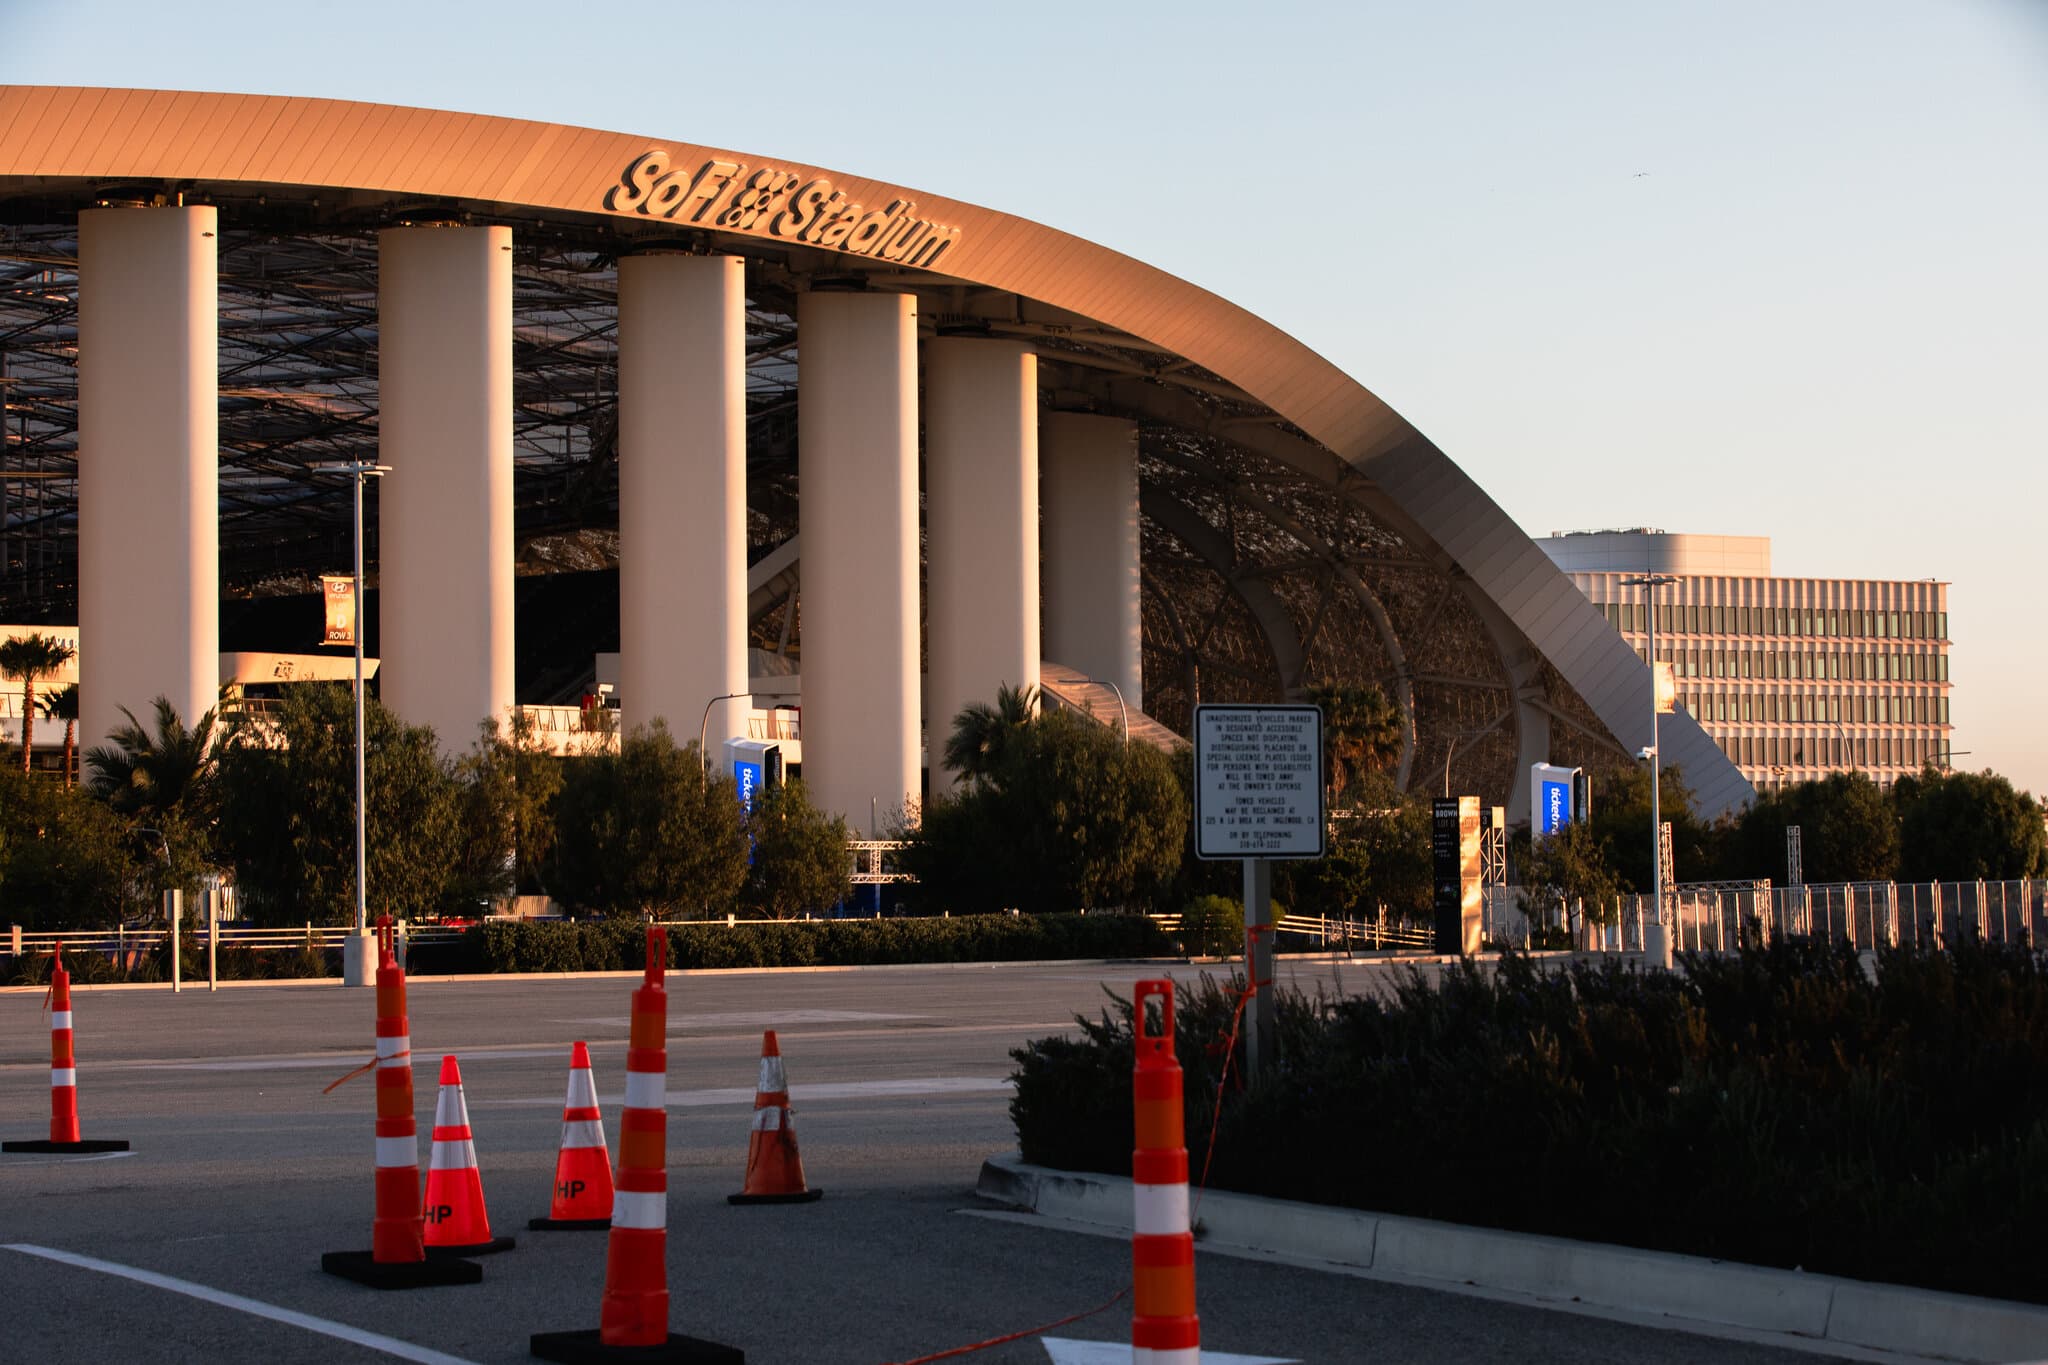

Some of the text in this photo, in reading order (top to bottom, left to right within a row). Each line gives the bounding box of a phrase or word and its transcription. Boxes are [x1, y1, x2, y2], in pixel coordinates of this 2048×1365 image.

[604, 150, 962, 267] SoFi Stadium
[329, 631, 347, 640] ROW
[743, 767, 754, 810] ticket
[557, 1180, 585, 1200] HP
[423, 1205, 452, 1225] HP
